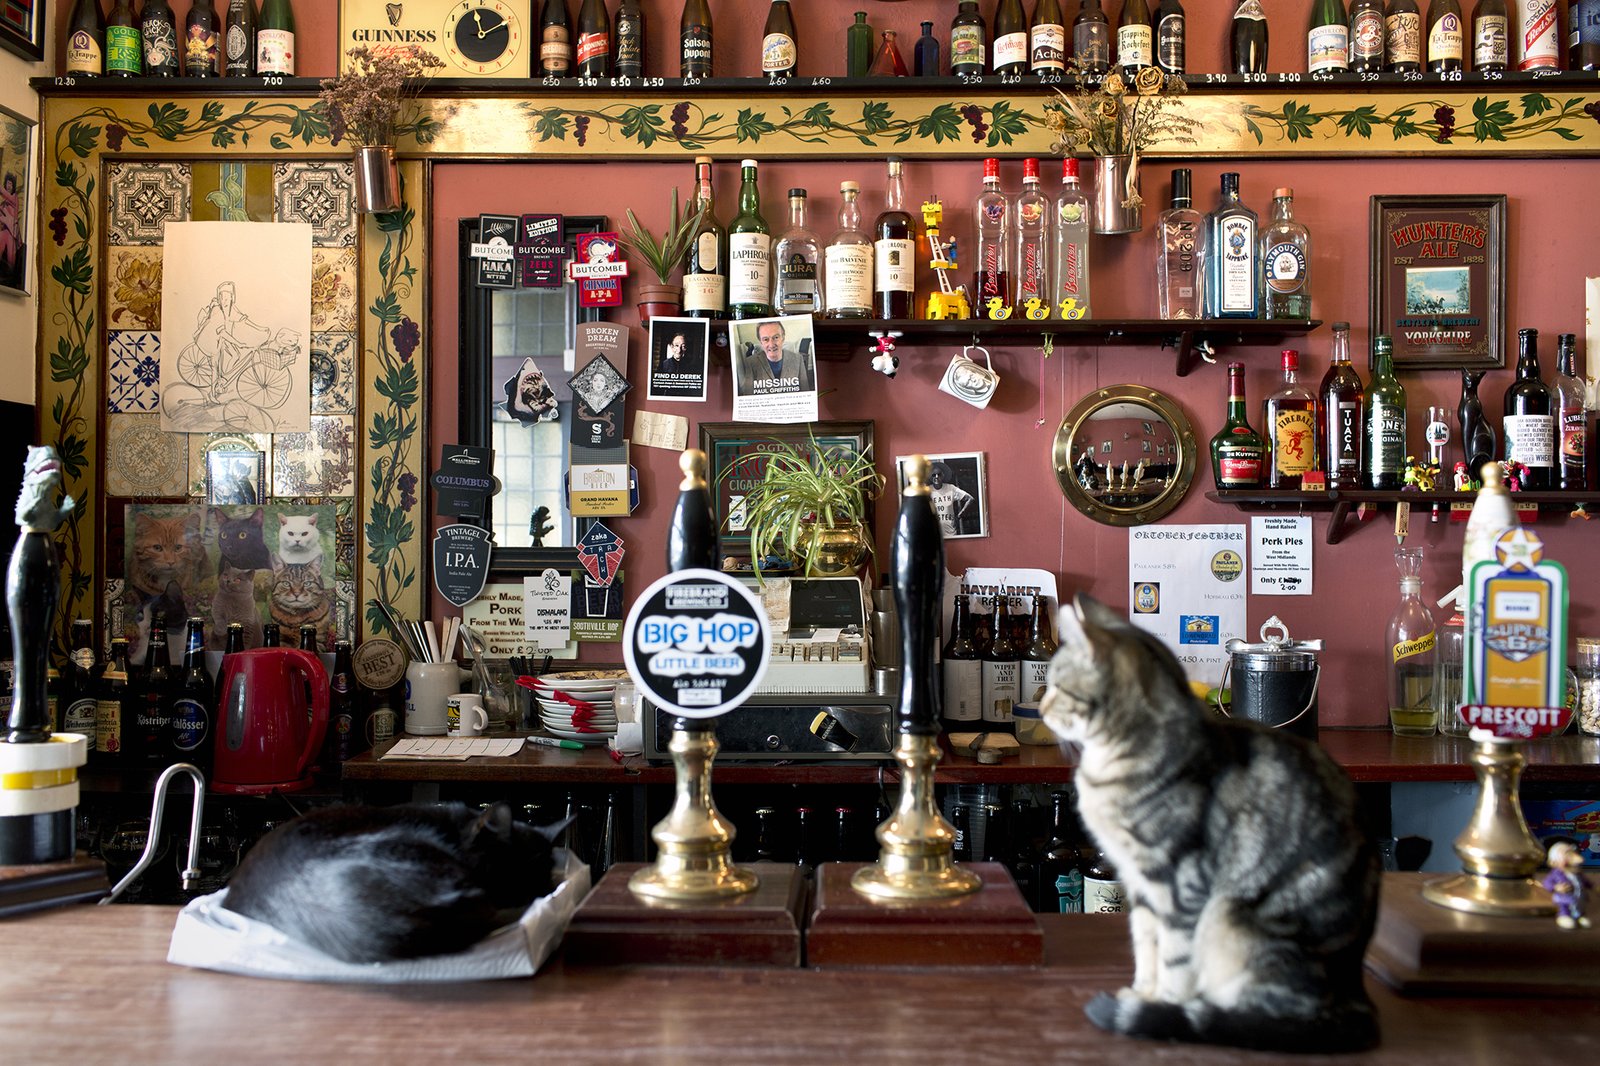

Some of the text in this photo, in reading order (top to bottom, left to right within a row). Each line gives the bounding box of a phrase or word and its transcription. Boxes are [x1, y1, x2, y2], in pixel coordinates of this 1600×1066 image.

[352, 28, 437, 43] GUINNESS
[1312, 28, 1344, 37] CANTILLON
[1527, 22, 1546, 44] Red
[684, 38, 711, 48] Saison
[684, 49, 711, 59] Dupont
[262, 76, 283, 86] 7.00
[962, 74, 983, 84] 3.50
[1040, 74, 1061, 84] 4.20
[1206, 74, 1228, 83] 3.90
[1244, 73, 1267, 83] 5.00
[1313, 74, 1334, 82] 6.40
[1360, 73, 1380, 82] 3.50
[1403, 72, 1423, 81] 5.60
[1440, 72, 1462, 81] 6.20
[1483, 72, 1502, 81] 5.50
[578, 78, 598, 87] 3.60
[610, 78, 631, 87] 6.50
[643, 78, 664, 87] 4.50
[526, 218, 558, 232] LIMITED
[1226, 222, 1249, 233] BOMBAY
[528, 225, 559, 238] EDITION
[1391, 221, 1487, 249] HUNTER'S
[1418, 242, 1459, 259] ALE
[1225, 255, 1249, 263] SAPPHIRE
[1266, 246, 1306, 271] PLYMOUTH GIN
[1394, 256, 1485, 266] EST 1828
[482, 261, 512, 273] HAKA
[530, 261, 554, 269] ZEUS
[576, 264, 624, 275] BUTCOMBE
[782, 264, 814, 274] JURA
[984, 244, 998, 295] Berentzen
[1023, 244, 1037, 294] Berentzen
[1064, 243, 1078, 294] Berentzen
[750, 270, 759, 280] 10
[583, 280, 617, 290] CHINOOK
[586, 328, 619, 336] BROKEN
[588, 335, 617, 343] DREAM
[1405, 331, 1473, 345] YORKSHIRE
[753, 377, 800, 389] MISSING
[1344, 409, 1353, 452] TUACA
[436, 475, 490, 488] COLUMBUS
[584, 472, 616, 486] BRIGHTON
[446, 528, 481, 539] TINTAGEL
[1262, 537, 1304, 546] Pork Pies
[446, 552, 480, 569] I.P.A.
[1261, 577, 1277, 585] Only
[960, 584, 1042, 597] HAYMARKET
[499, 593, 524, 601] MADE,
[982, 597, 1023, 607] RAER
[490, 603, 522, 615] PORK
[470, 618, 492, 626] FROM
[573, 622, 619, 631] SOUTHVILLE HOP
[644, 623, 754, 644] BIG HOP
[490, 646, 514, 654] ONLY
[518, 646, 524, 654] £
[1396, 638, 1435, 658] Schweppes
[362, 653, 396, 676] BEST
[656, 658, 740, 670] LITTLE BEER
[1469, 706, 1561, 726] PRESCOTT
[173, 718, 204, 730] chlösser
[822, 719, 838, 740] GUINNESS
